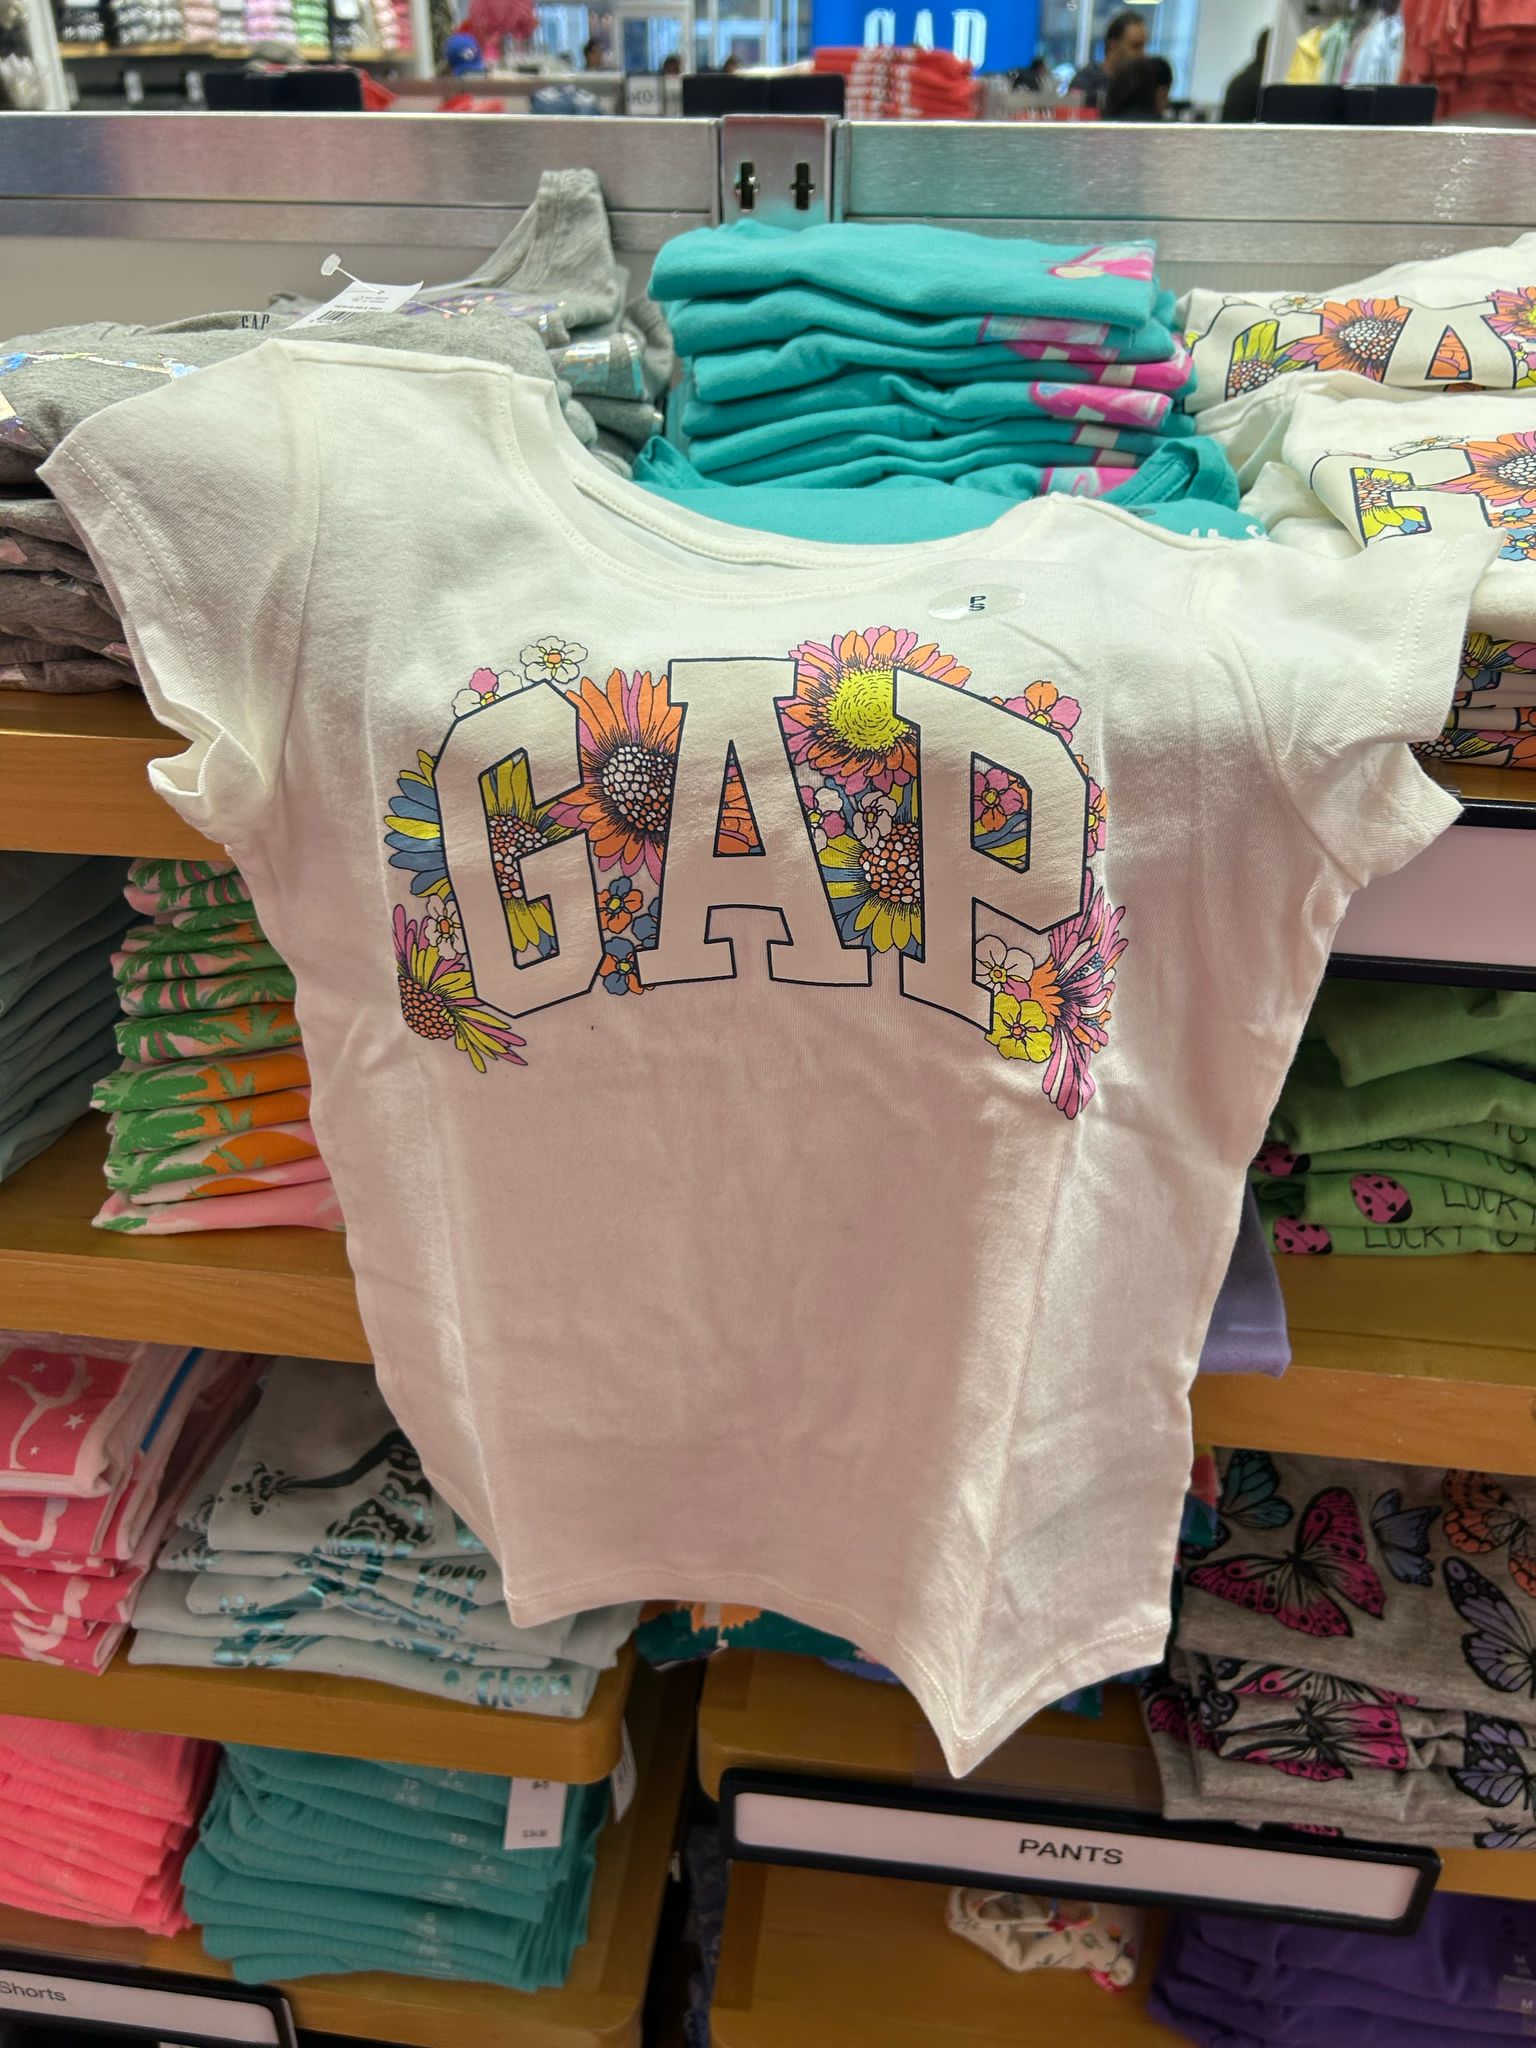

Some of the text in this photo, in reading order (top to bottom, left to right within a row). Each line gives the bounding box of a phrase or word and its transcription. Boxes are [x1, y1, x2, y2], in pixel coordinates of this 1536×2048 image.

[433, 656, 1090, 1035] GAP
[1019, 1838, 1124, 1865] PANTS
[0, 1981, 67, 2002] Shorts
